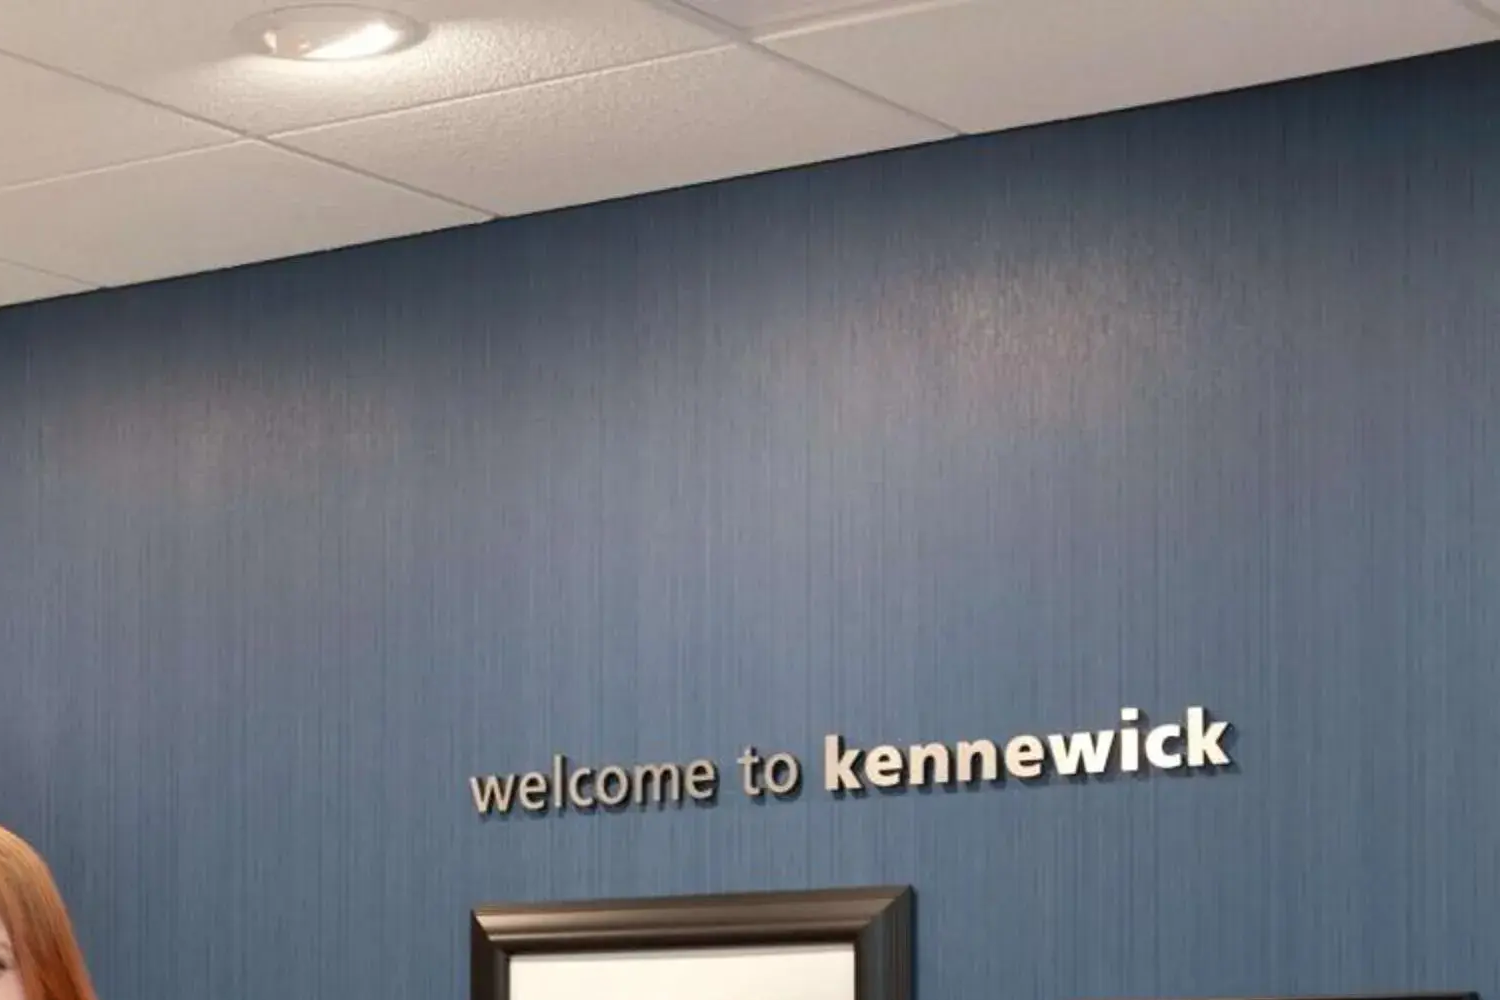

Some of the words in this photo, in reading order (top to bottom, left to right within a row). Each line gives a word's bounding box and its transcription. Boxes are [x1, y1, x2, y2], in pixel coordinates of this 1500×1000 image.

[469, 754, 716, 813] welcome
[736, 744, 800, 796] to
[823, 706, 1231, 792] kennewick
